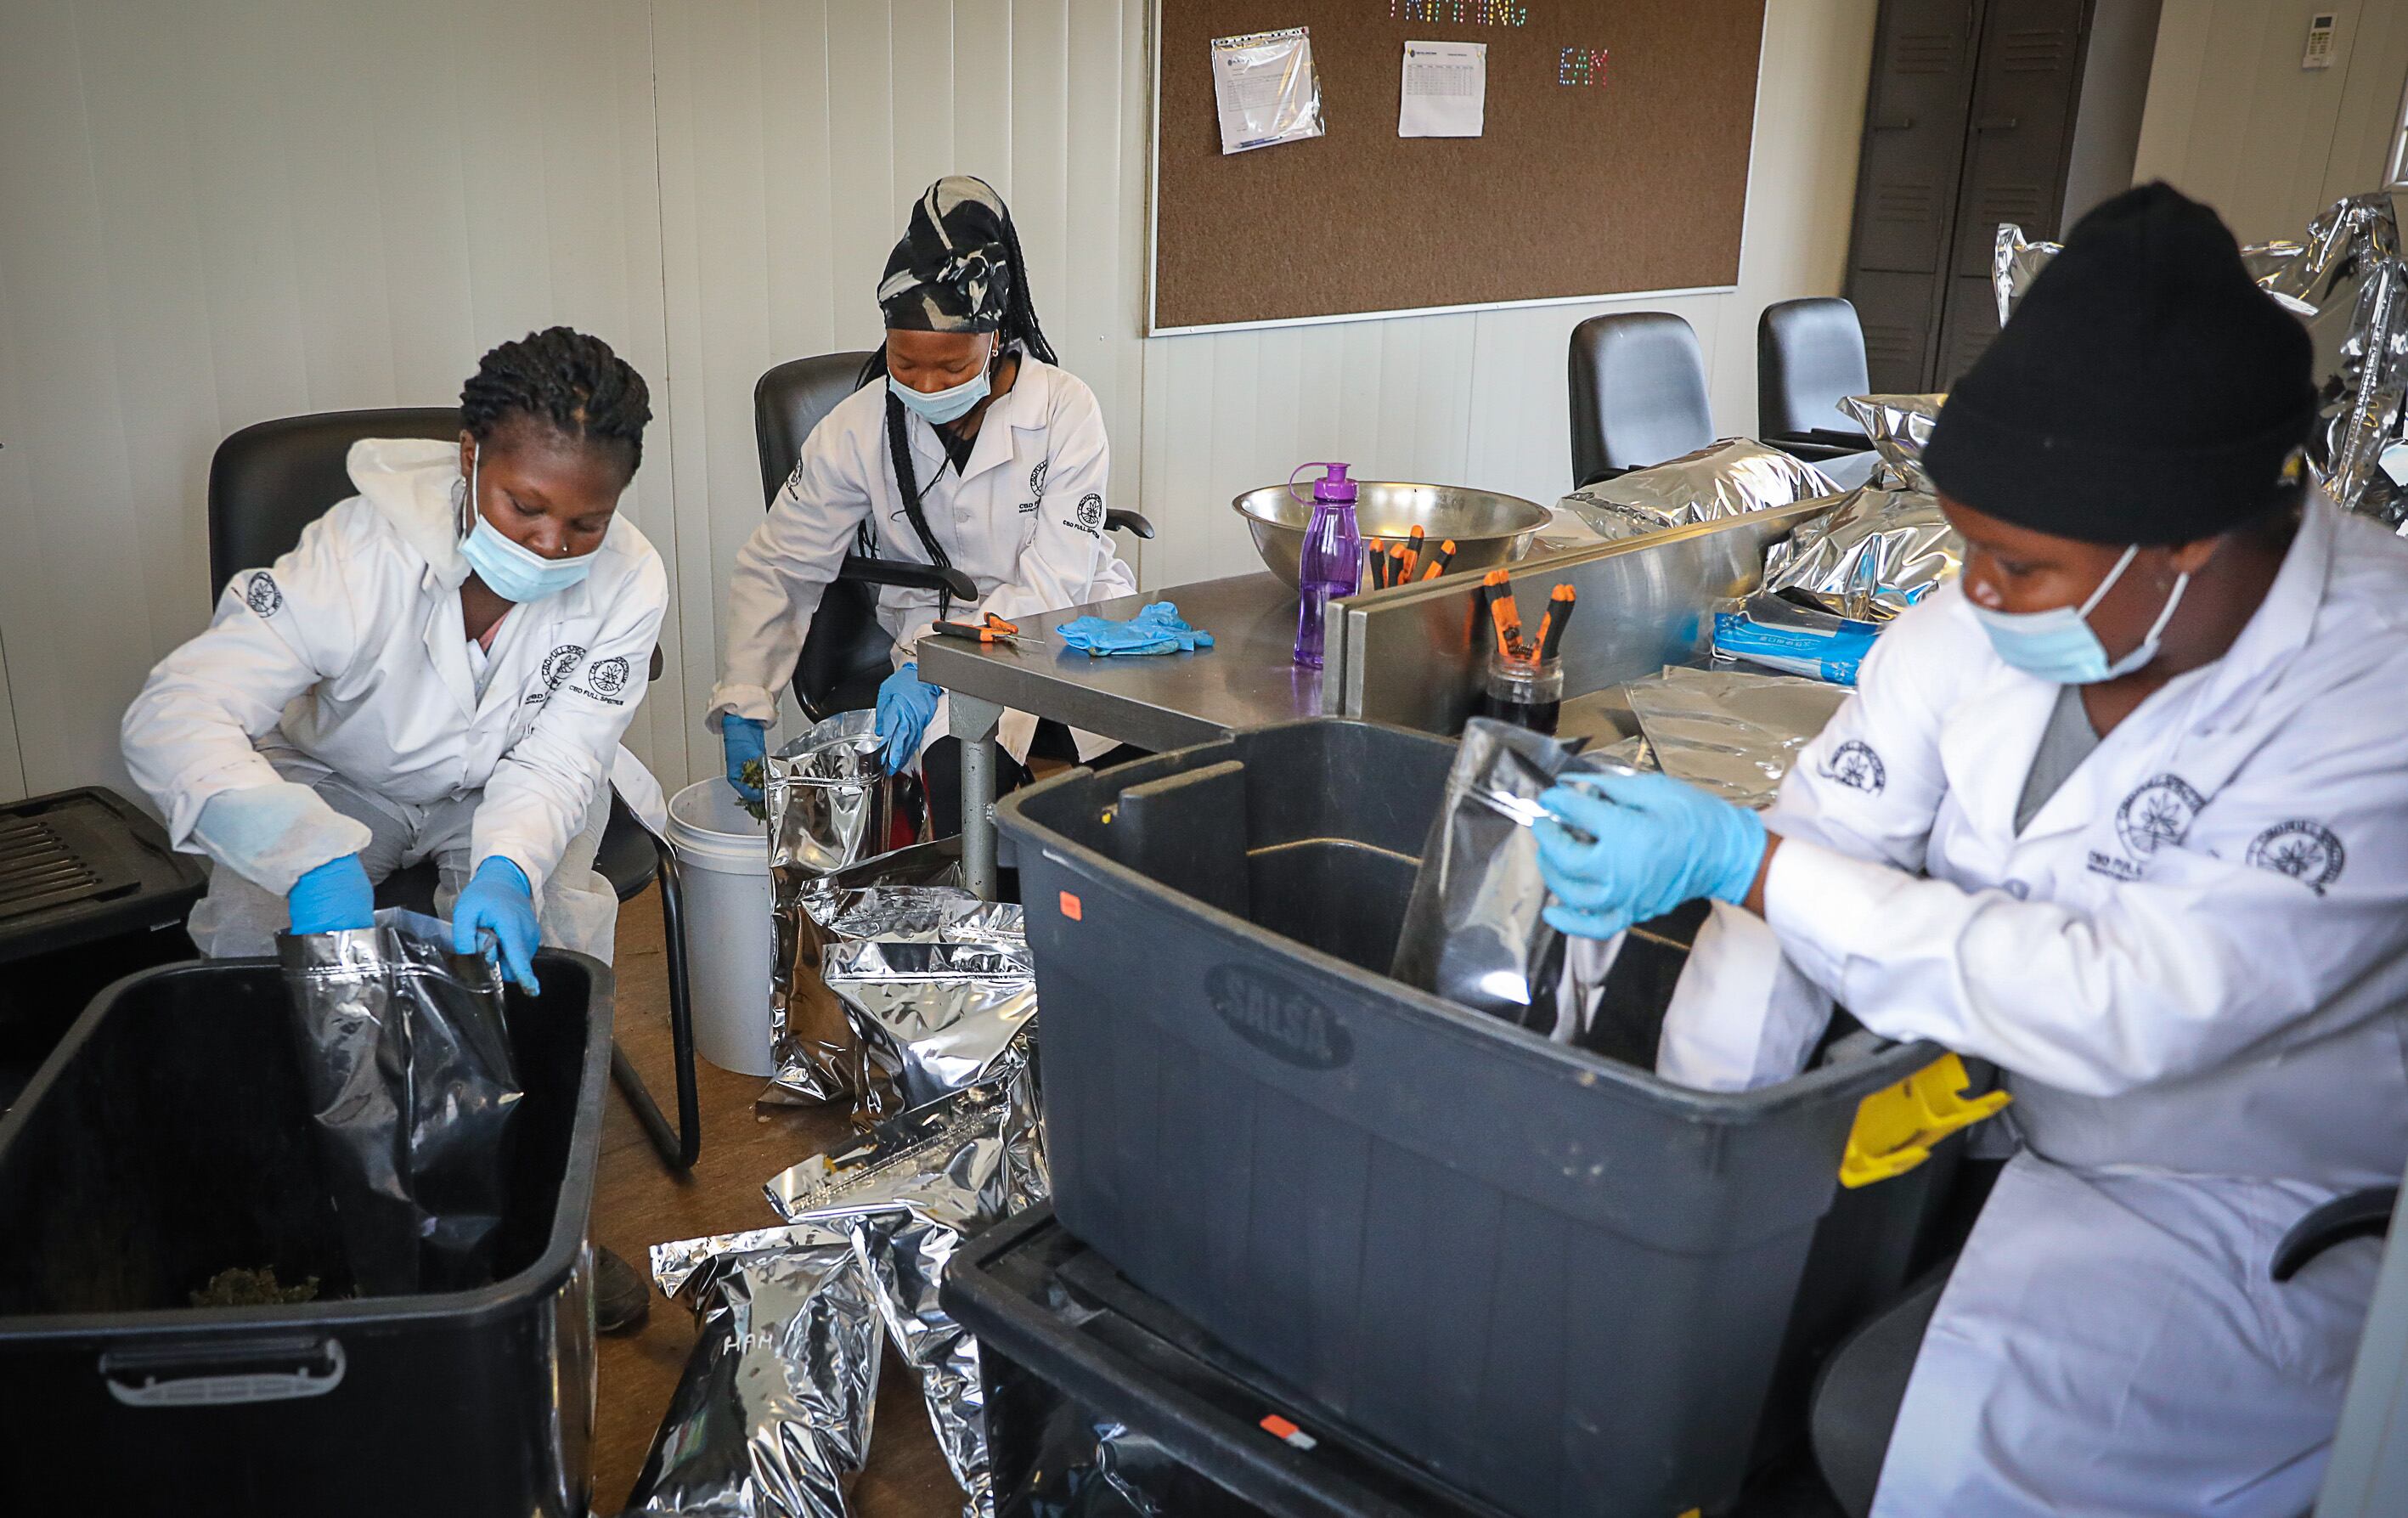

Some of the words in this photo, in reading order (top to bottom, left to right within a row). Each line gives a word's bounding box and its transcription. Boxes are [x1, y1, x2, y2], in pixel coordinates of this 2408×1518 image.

[1559, 47, 1608, 87] EAM
[568, 685, 583, 694] CBD
[584, 690, 600, 701] FULL
